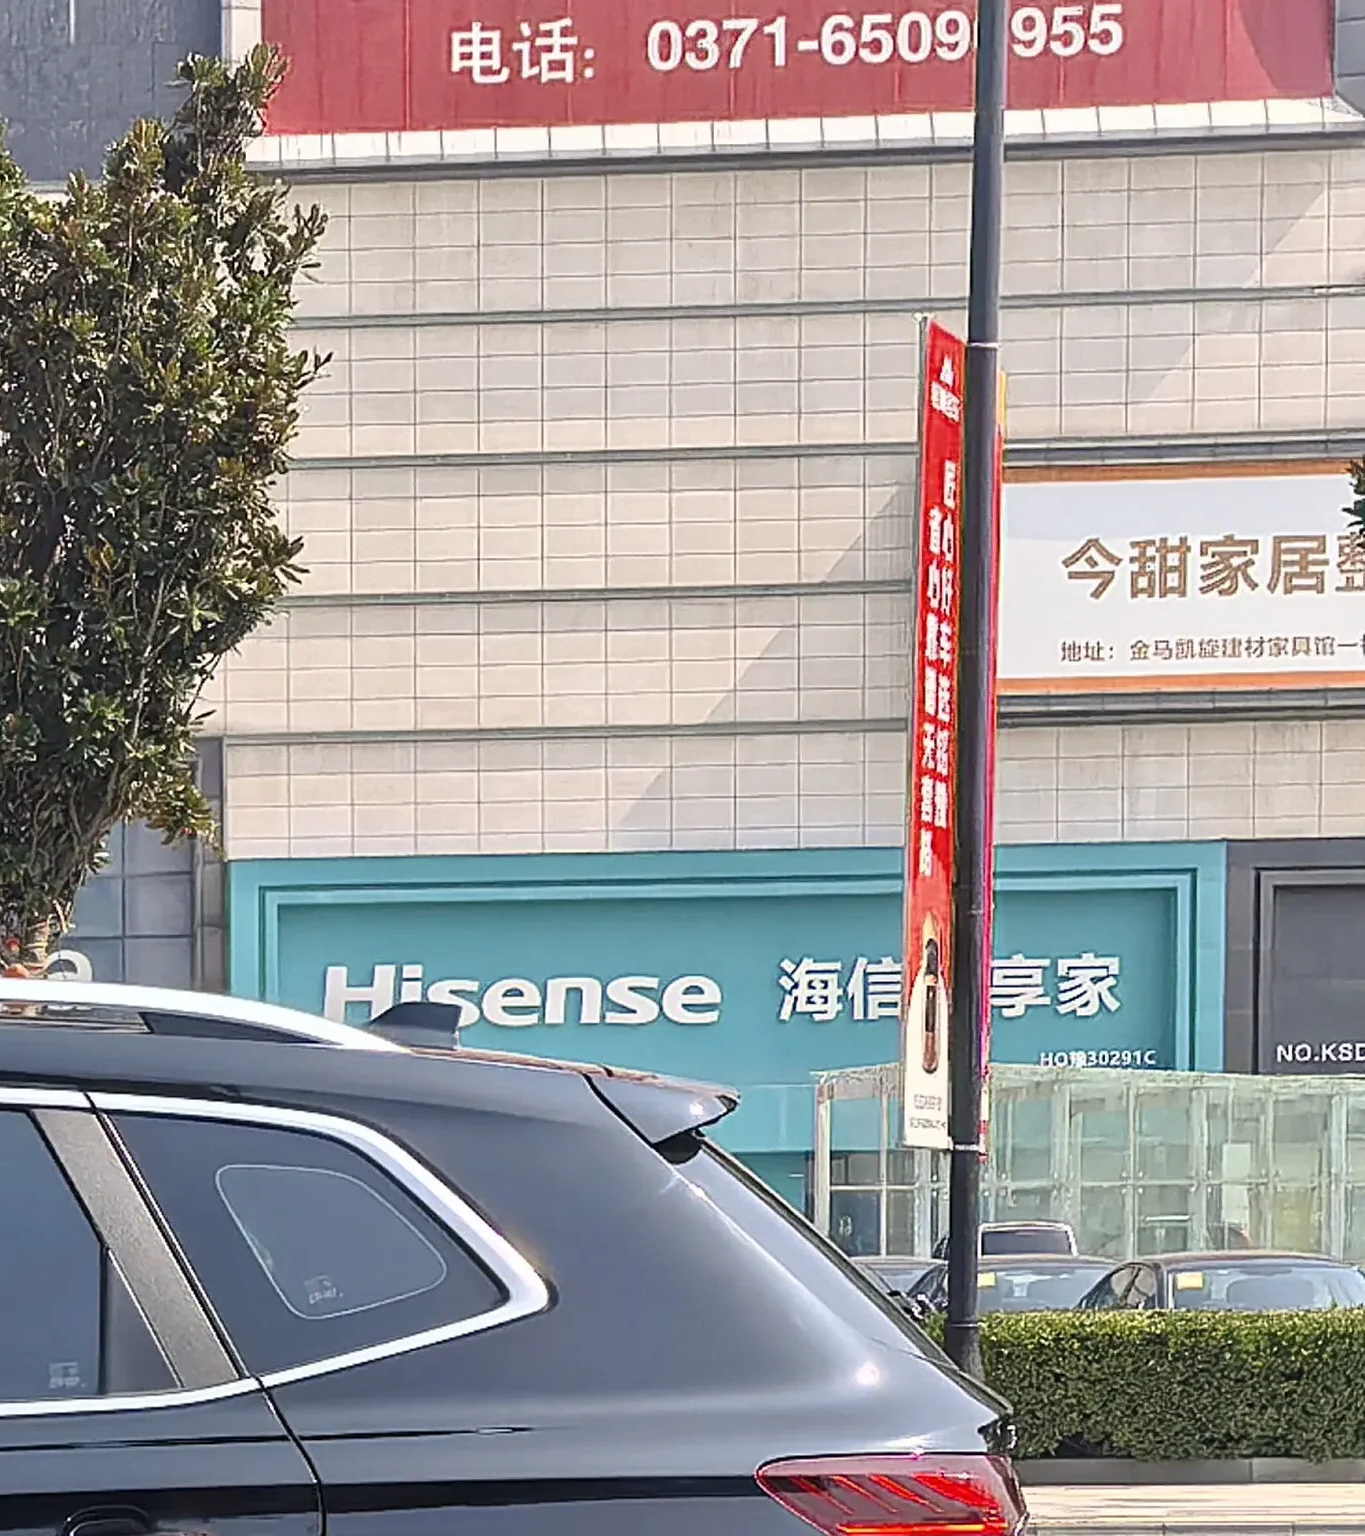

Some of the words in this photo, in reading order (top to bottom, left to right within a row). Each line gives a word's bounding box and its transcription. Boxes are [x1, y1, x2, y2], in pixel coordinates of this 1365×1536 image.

[647, 4, 1123, 72] 0371-6509955
[1130, 635, 1365, 661] 金马凯旋建材家具馆一
[323, 963, 723, 1027] Hisense
[777, 954, 1121, 1022] 海信享家
